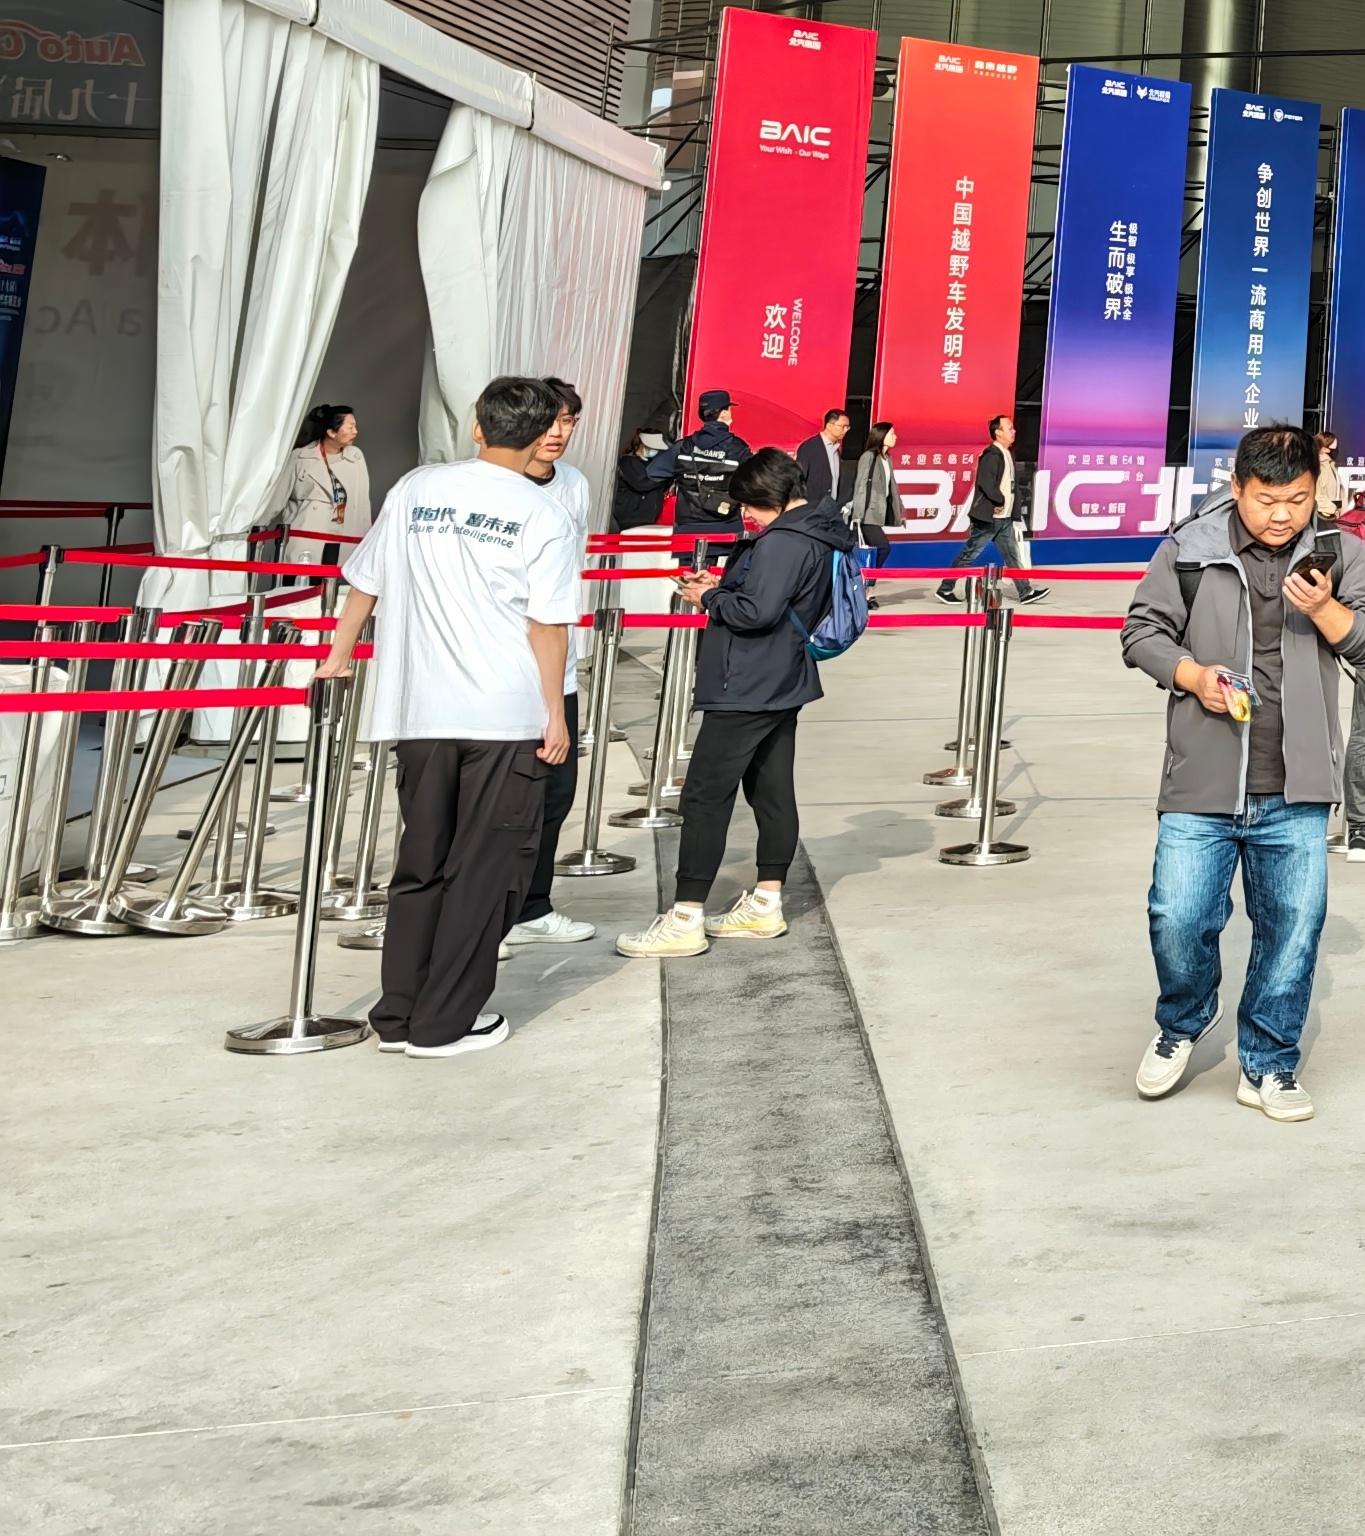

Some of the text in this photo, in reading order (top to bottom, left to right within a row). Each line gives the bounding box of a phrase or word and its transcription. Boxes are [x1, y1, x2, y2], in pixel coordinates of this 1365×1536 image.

[760, 120, 831, 146] BAIC
[776, 146, 792, 155] Wish
[941, 176, 974, 384] 中国越野车发明者
[1104, 220, 1127, 320] 生而破界
[1243, 163, 1274, 429] 争创世界一流商用车企业
[761, 304, 788, 359] 欢迎
[788, 298, 803, 366] WELCOME
[438, 524, 450, 534] of
